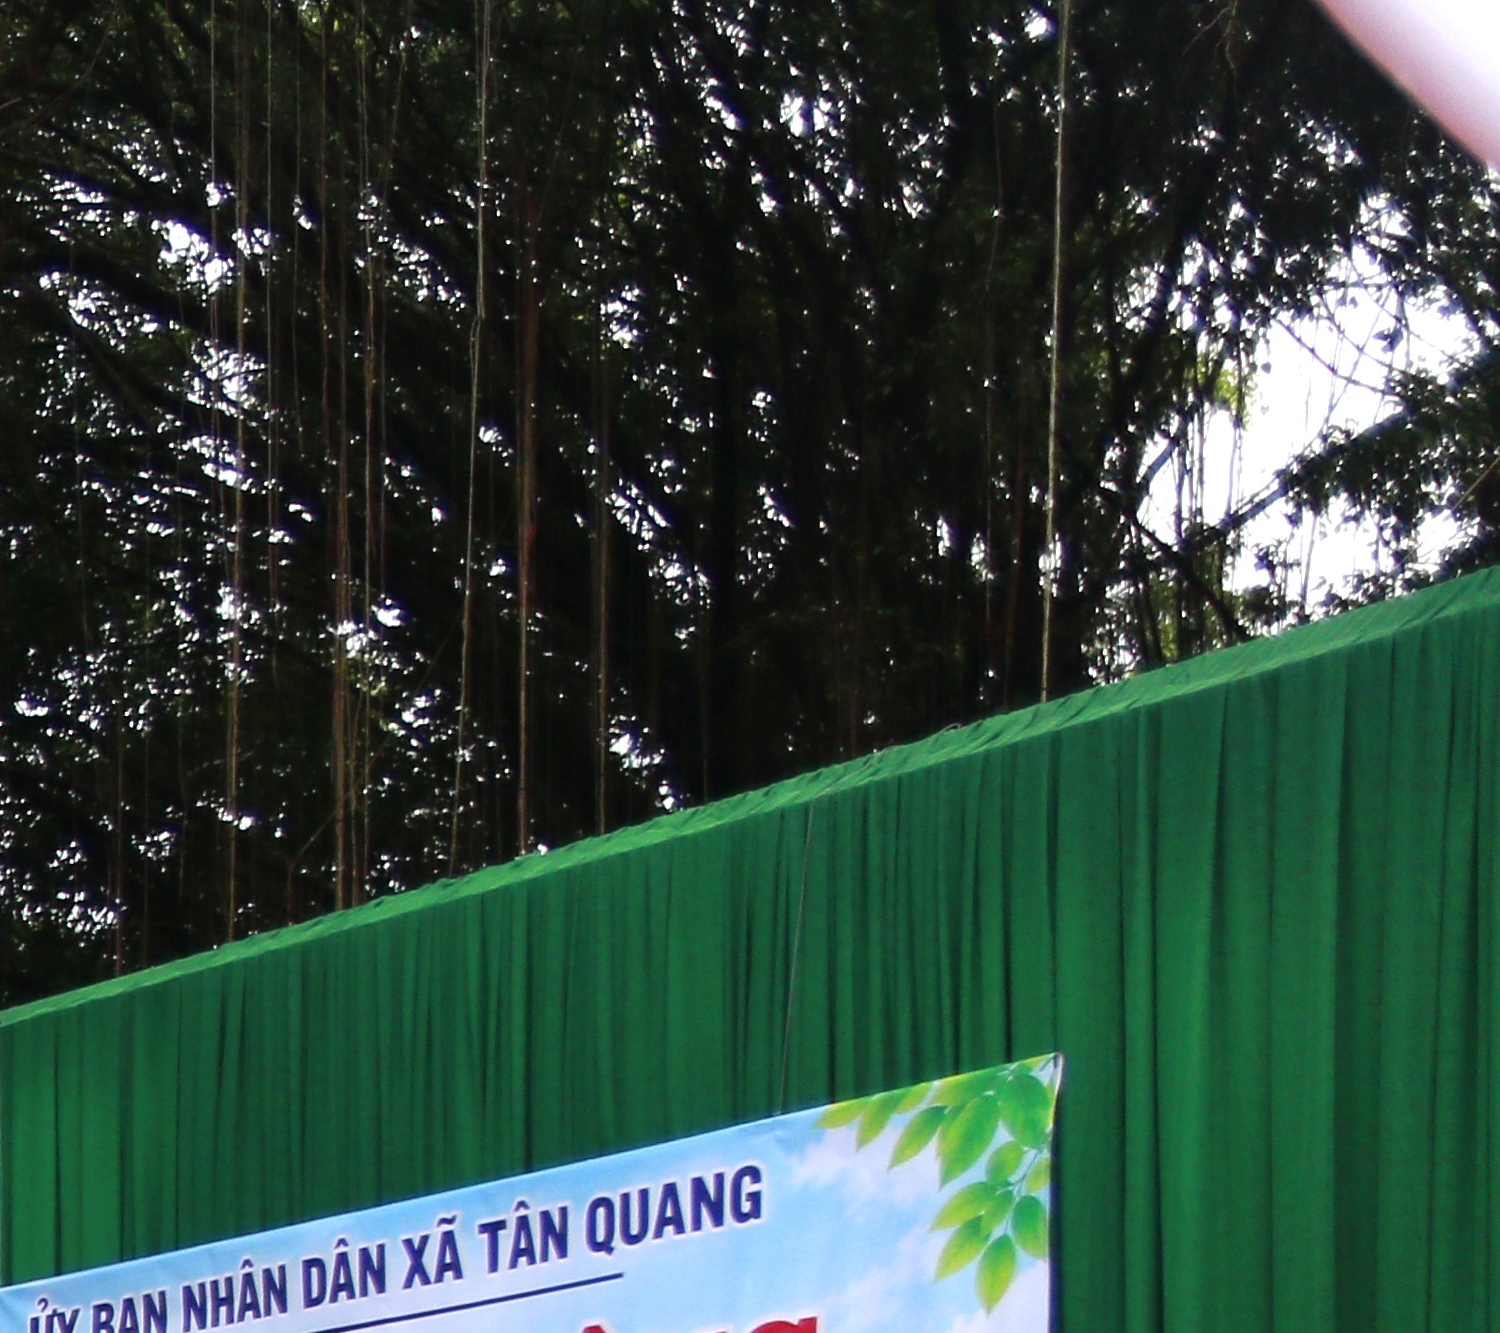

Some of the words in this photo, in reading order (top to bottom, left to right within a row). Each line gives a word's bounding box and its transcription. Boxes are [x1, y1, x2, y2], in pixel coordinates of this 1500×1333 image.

[183, 1259, 287, 1332] NHÂN
[302, 1238, 385, 1308] DÂN
[402, 1216, 463, 1289] XÃ
[479, 1201, 568, 1273] TÂN
[587, 1166, 761, 1255] QUANG
